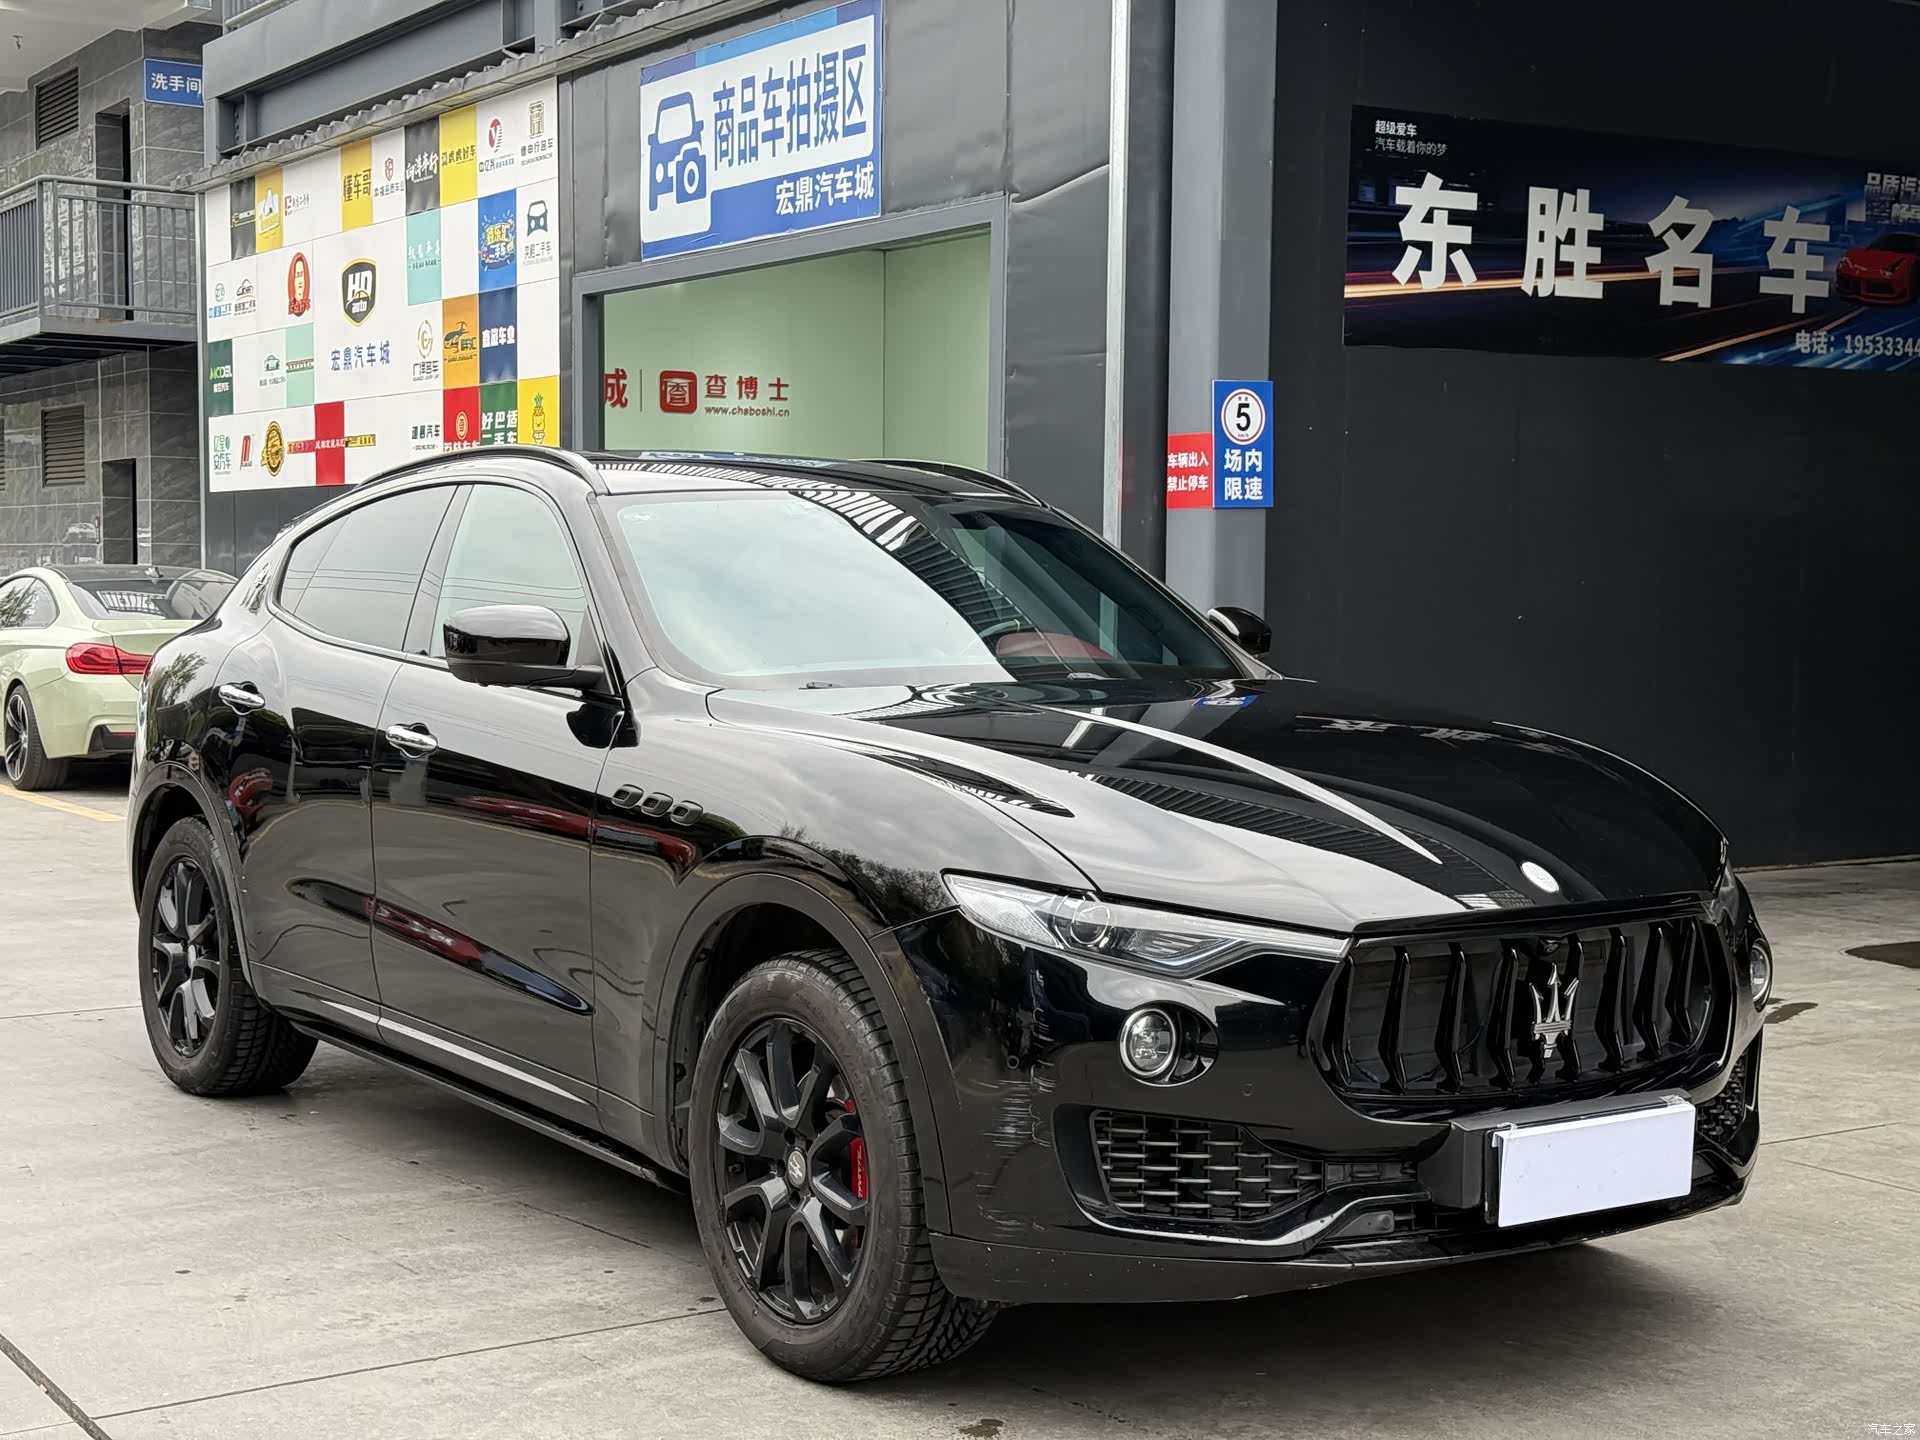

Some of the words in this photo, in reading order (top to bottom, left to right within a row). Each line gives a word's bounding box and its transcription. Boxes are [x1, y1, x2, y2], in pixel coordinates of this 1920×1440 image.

[151, 72, 202, 95] 洗手间
[712, 43, 867, 171] 商品车拍摄区
[1375, 119, 1418, 138] 超级爱车
[1375, 137, 1448, 157] 汽车载着你的梦
[775, 161, 875, 216] 宏鼎汽车城
[1391, 171, 1831, 314] 东胜名车
[704, 374, 790, 401] 查博士
[482, 410, 518, 430] 好巴适
[704, 406, 790, 417] www.chaboshi.cn
[1236, 403, 1251, 431] 5
[1167, 451, 1209, 468] 车辆出入
[1224, 448, 1263, 472] 场内
[1167, 475, 1209, 492] 禁止停车
[1224, 477, 1264, 501] 限速
